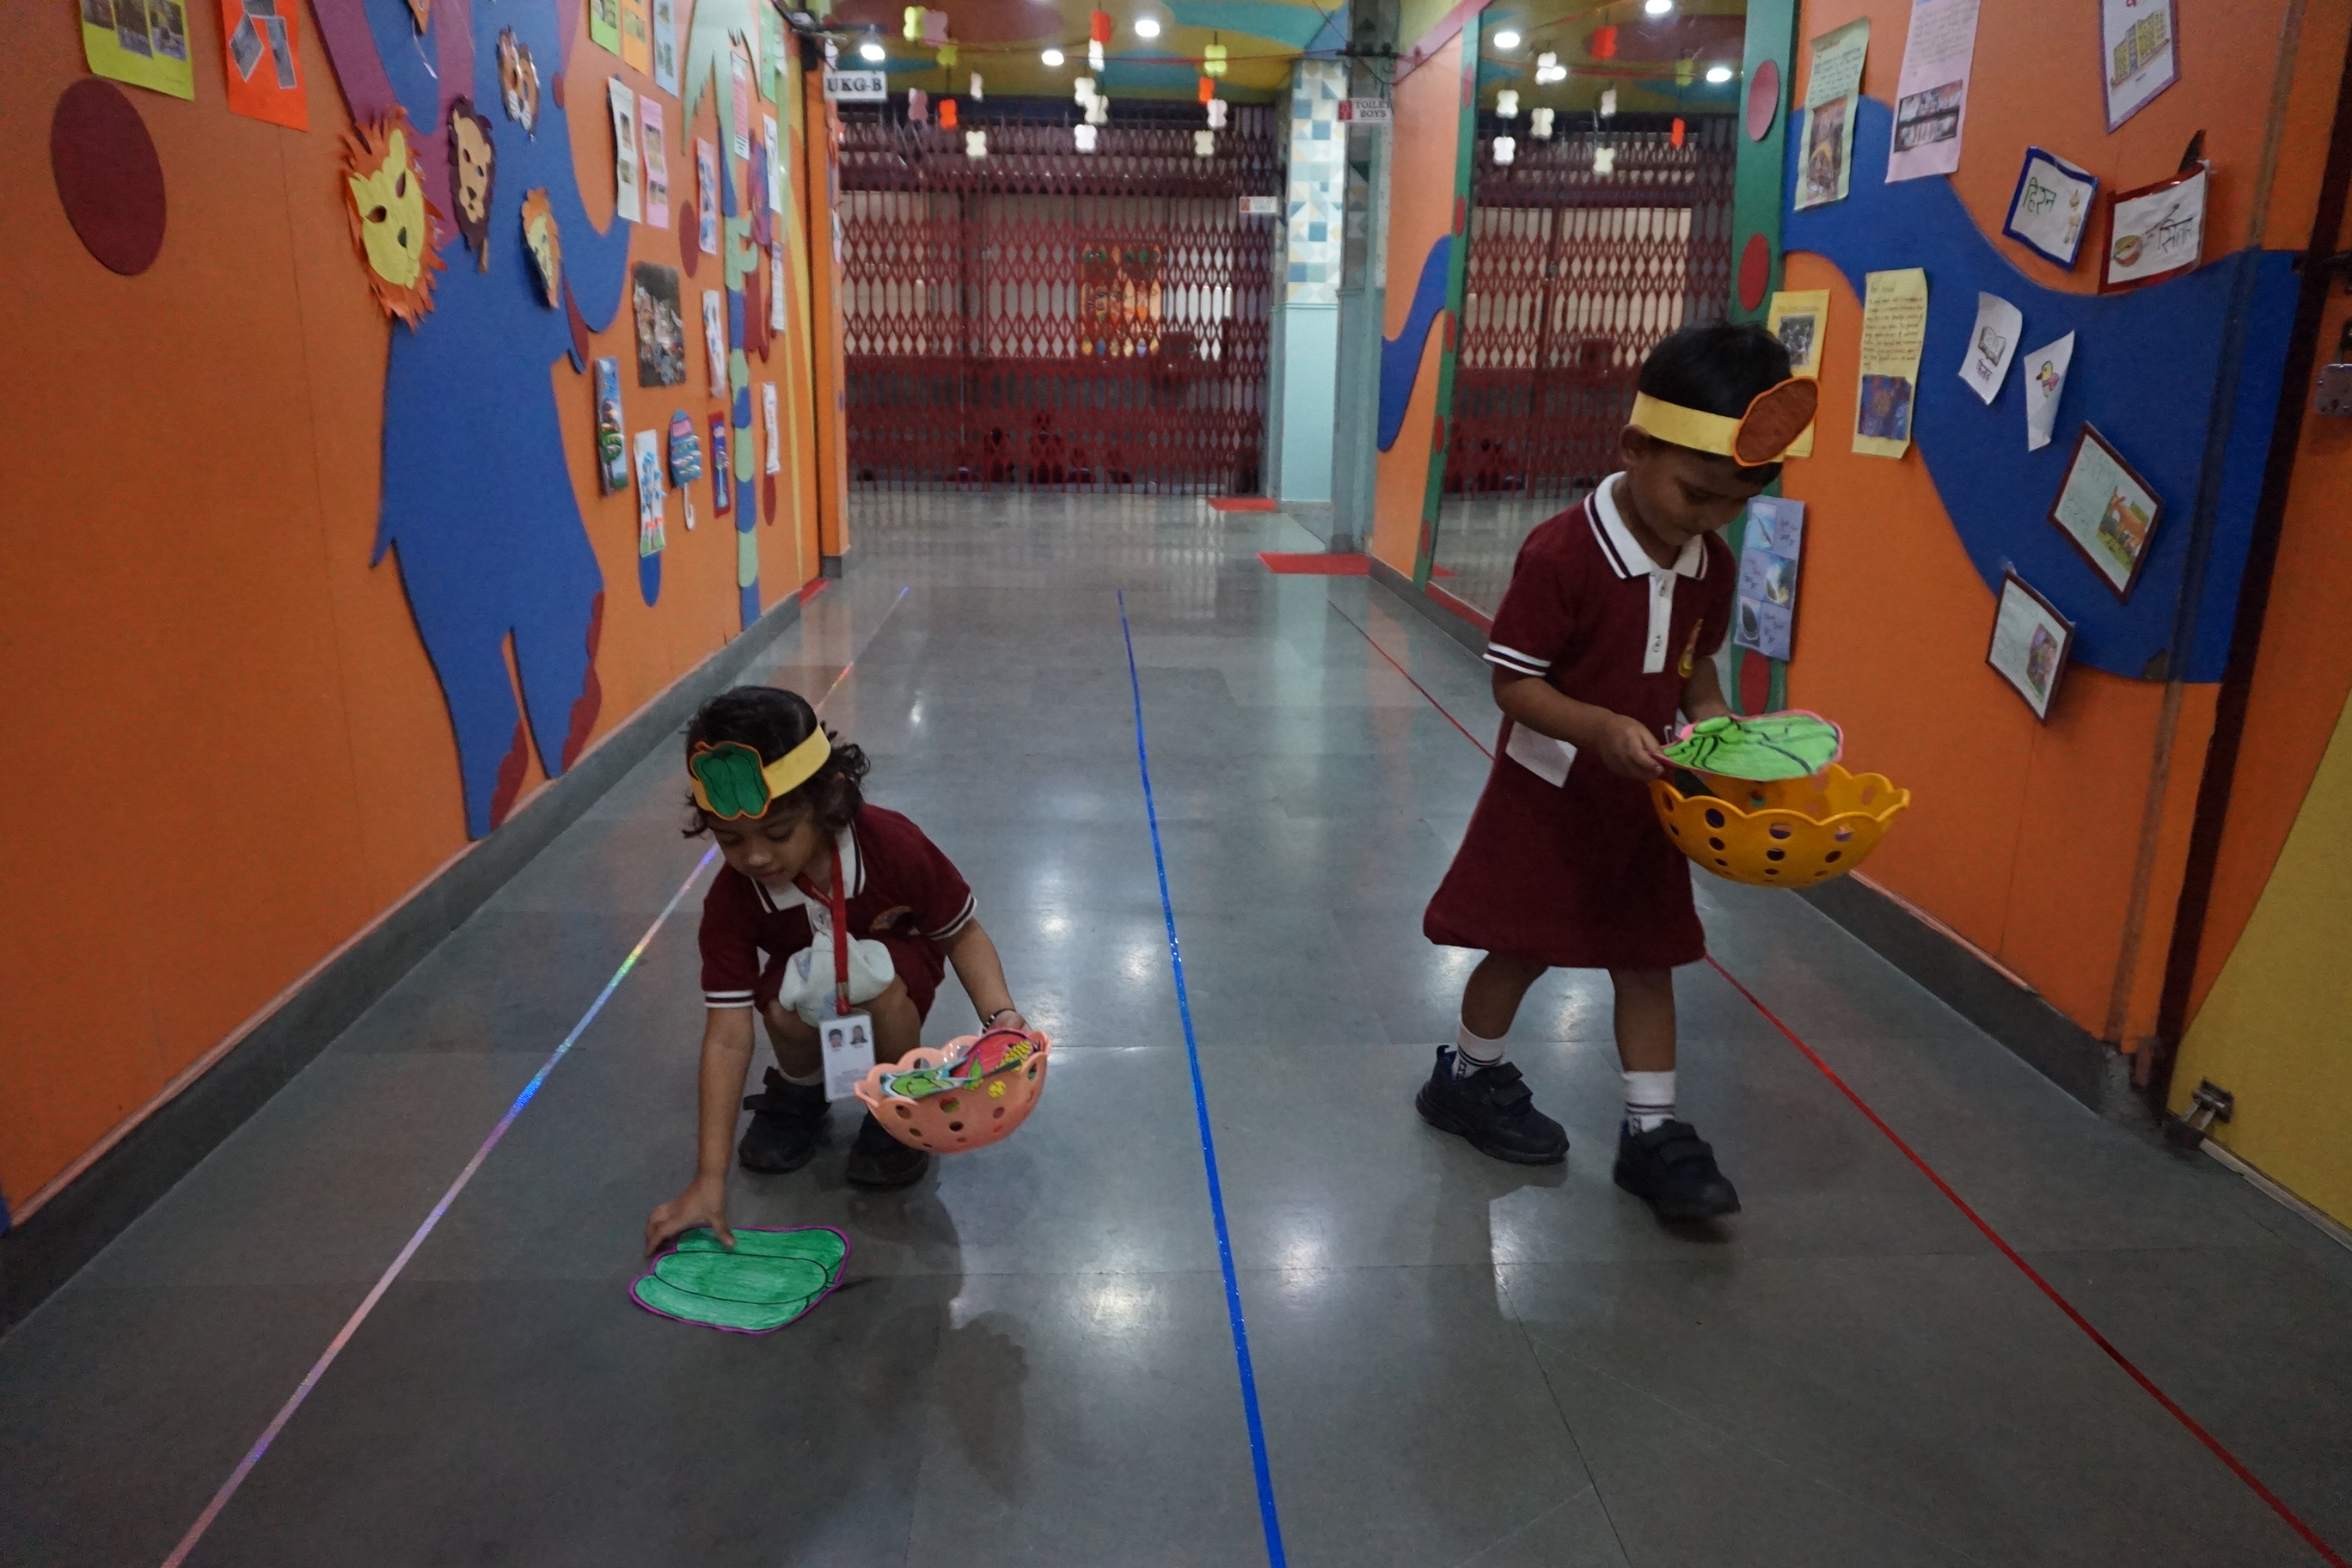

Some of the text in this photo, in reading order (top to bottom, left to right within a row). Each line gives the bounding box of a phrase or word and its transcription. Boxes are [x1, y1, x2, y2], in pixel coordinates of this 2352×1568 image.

[827, 77, 883, 92] UKG-B
[1356, 101, 1391, 109] TOILET
[1360, 109, 1387, 118] BOYS
